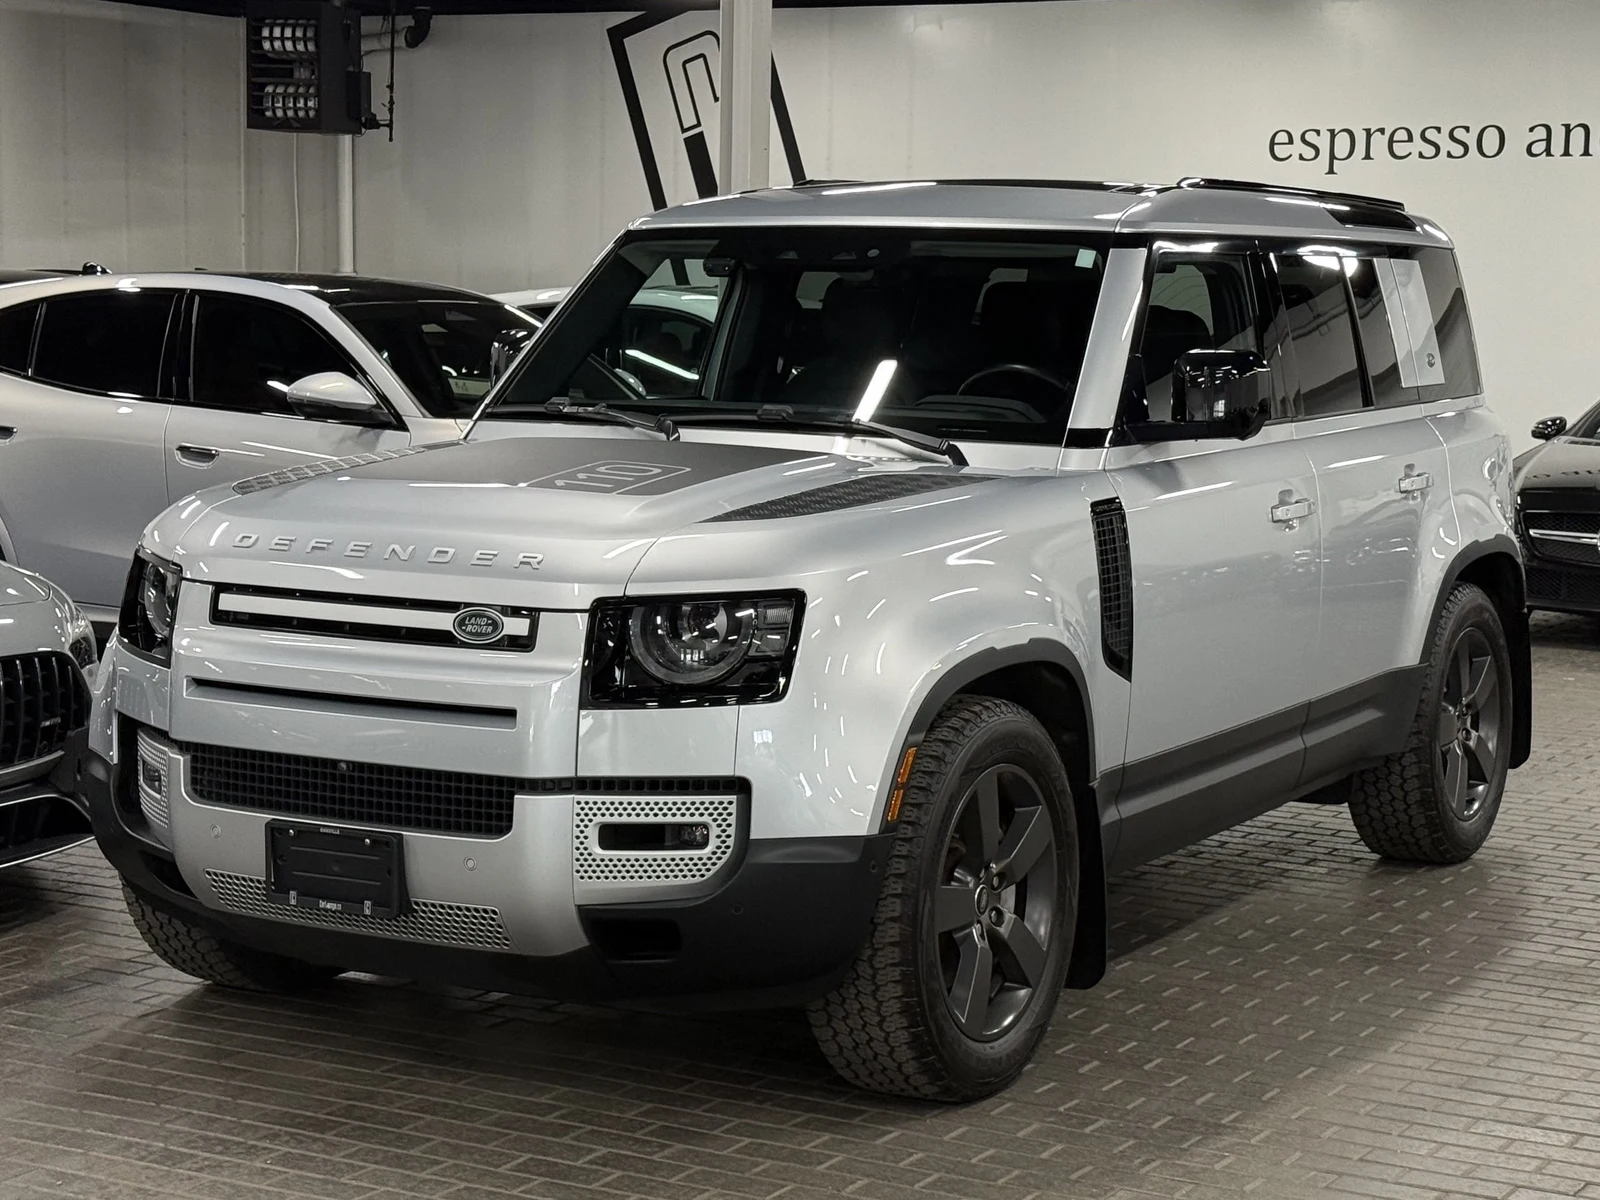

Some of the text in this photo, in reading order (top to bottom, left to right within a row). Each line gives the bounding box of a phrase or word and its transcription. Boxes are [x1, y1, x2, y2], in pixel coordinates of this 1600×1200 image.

[1268, 123, 1506, 175] espresso
[553, 464, 663, 488] 110
[232, 532, 545, 570] DEFENDER
